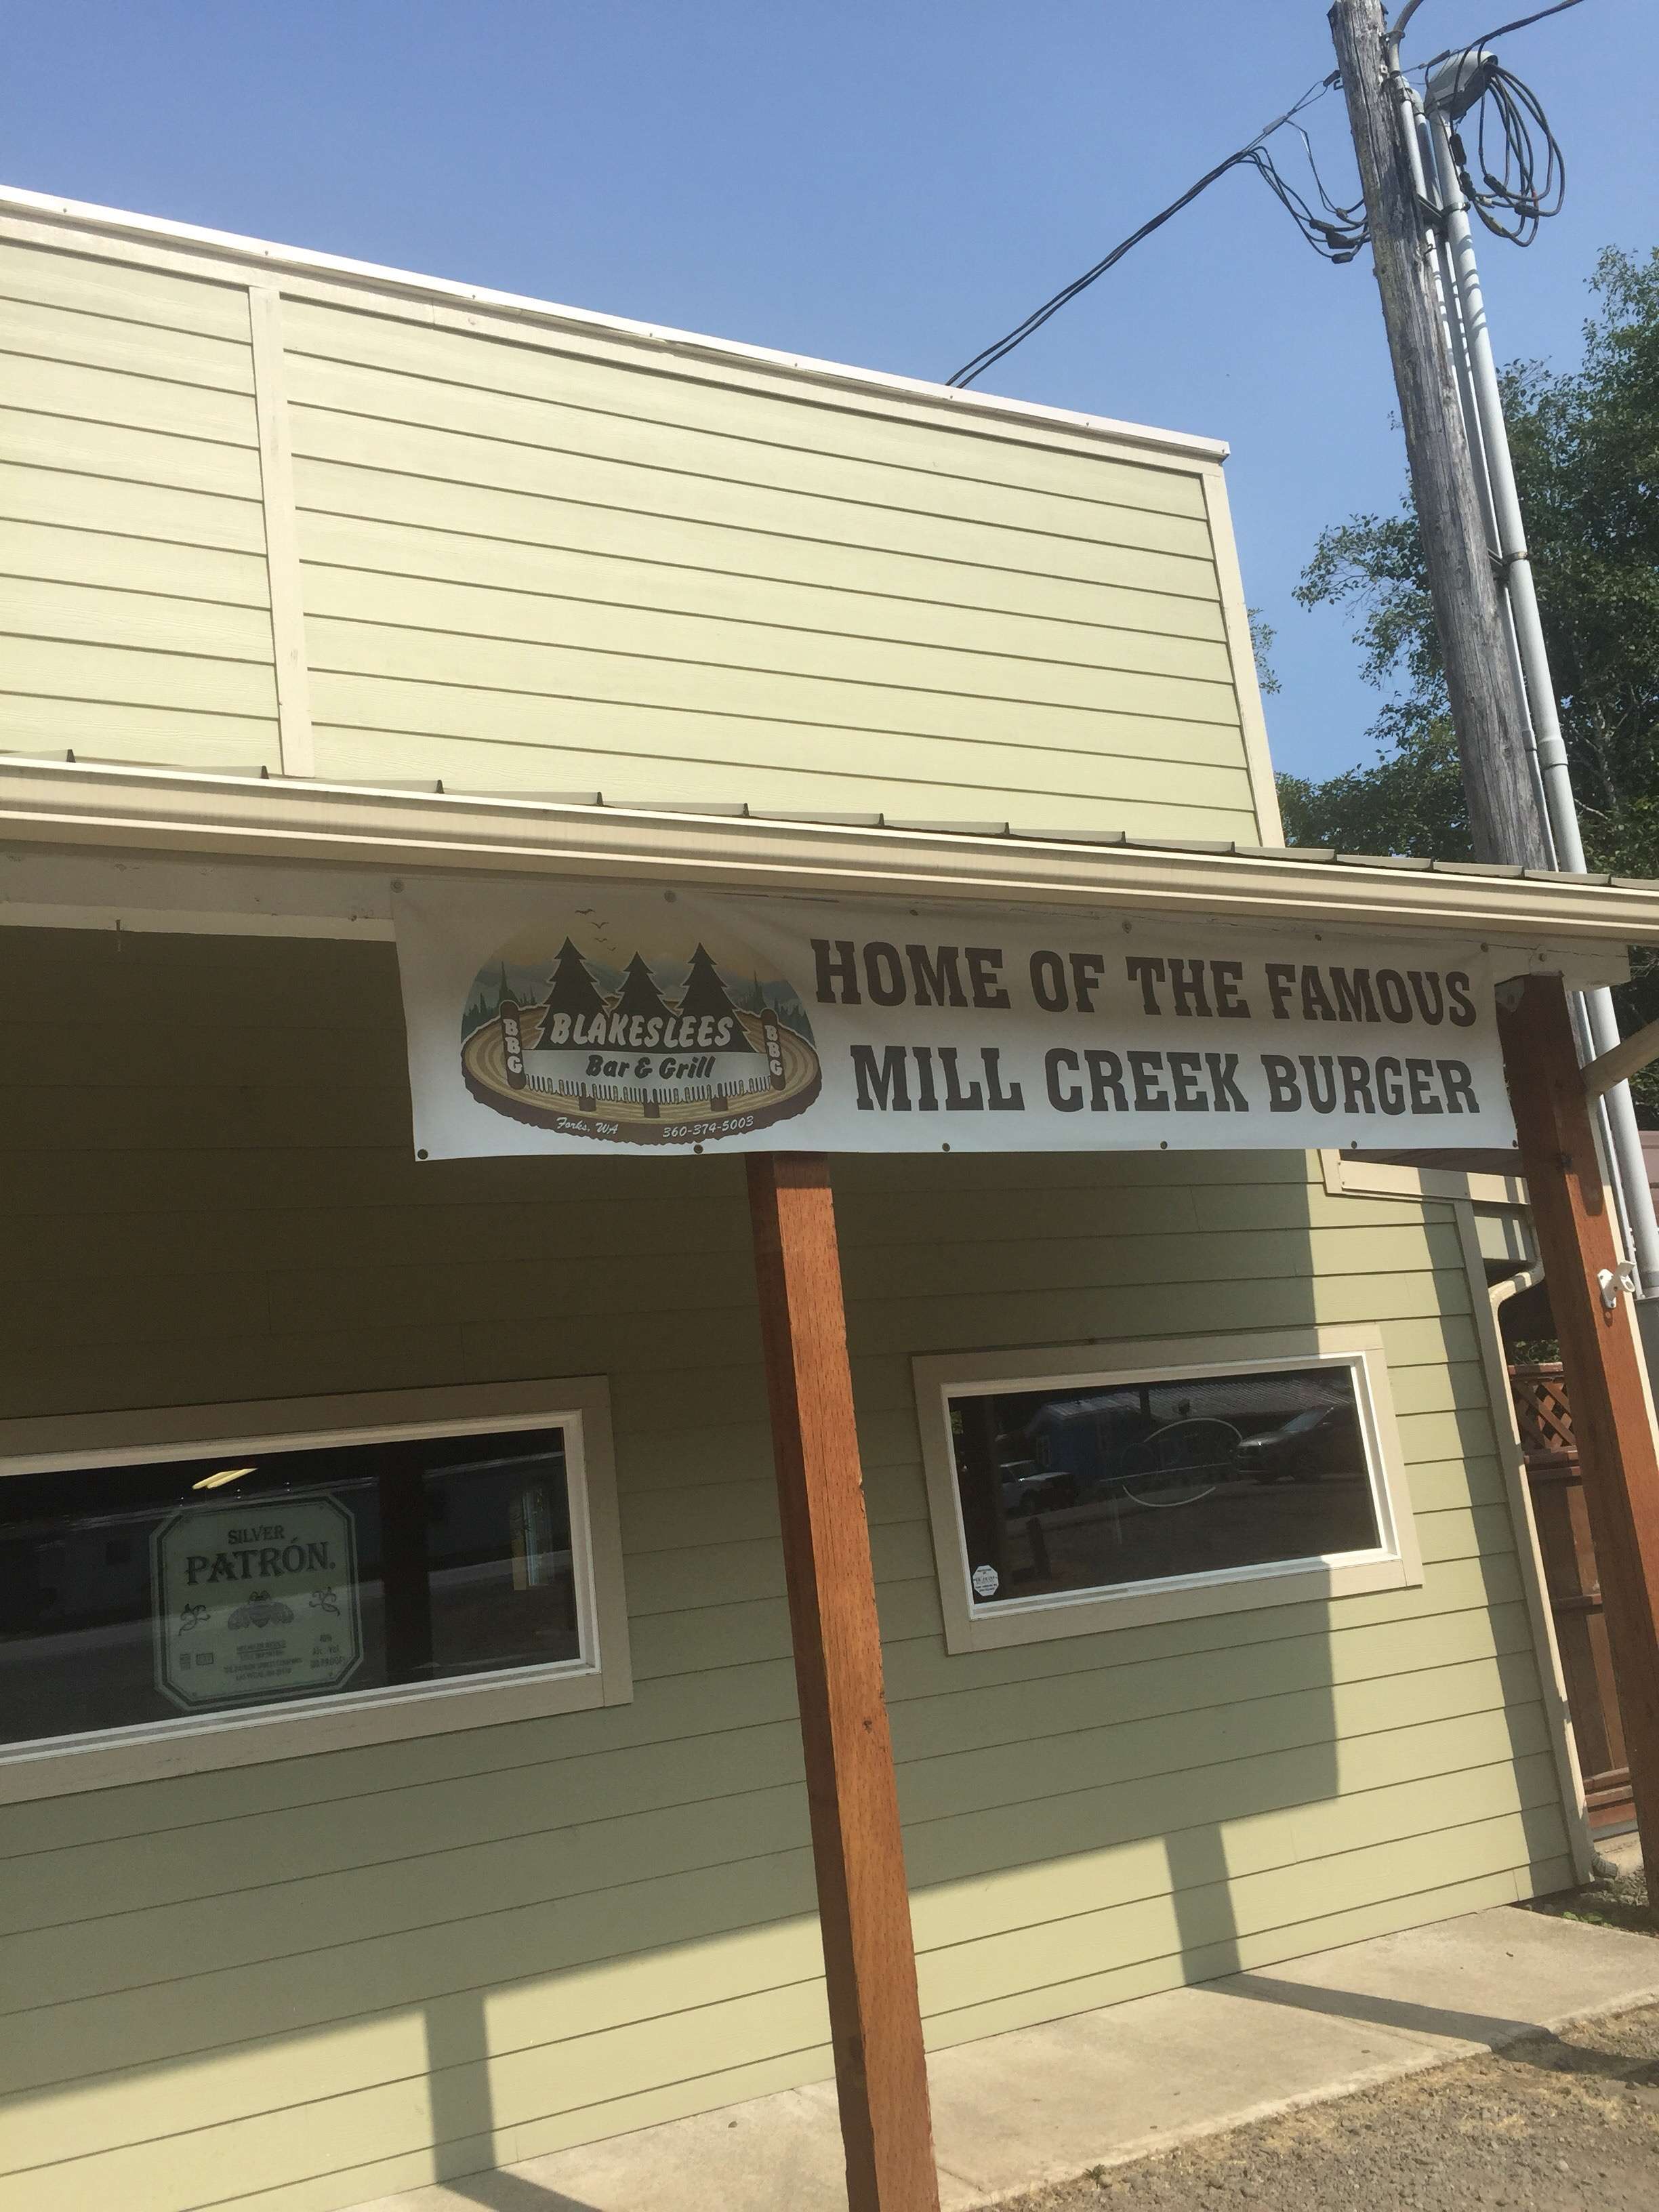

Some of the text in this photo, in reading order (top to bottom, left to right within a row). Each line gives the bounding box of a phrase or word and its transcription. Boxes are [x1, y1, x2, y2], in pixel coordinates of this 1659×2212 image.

[810, 939, 1477, 1027] HOME OF THE FAMOUS
[550, 1012, 733, 1048] BLAKESLEES
[586, 1054, 716, 1079] Bar & Grill
[850, 1045, 1480, 1115] MILL CREEK BURGER
[556, 1116, 619, 1134] Forks, WA
[663, 1115, 754, 1139] 360-374-5003
[228, 1525, 285, 1545] SILVER
